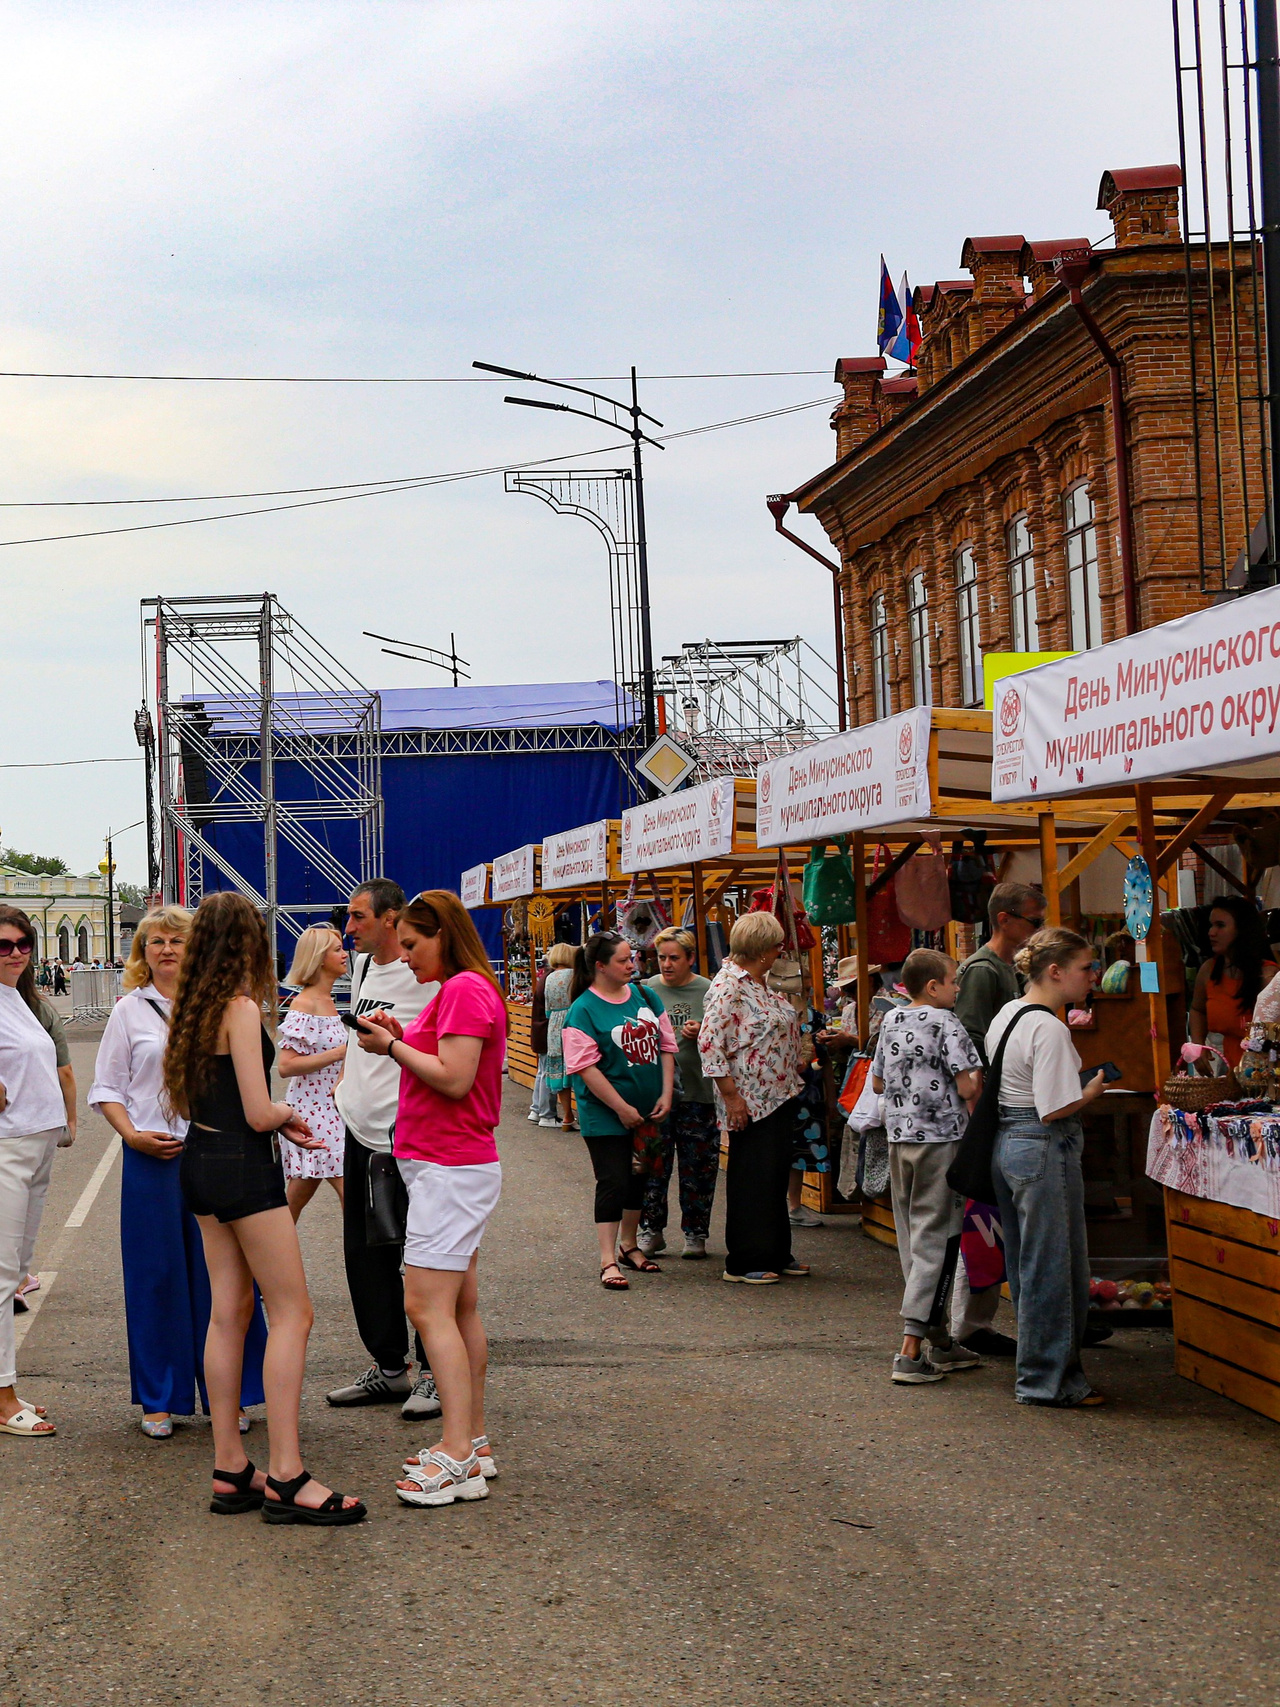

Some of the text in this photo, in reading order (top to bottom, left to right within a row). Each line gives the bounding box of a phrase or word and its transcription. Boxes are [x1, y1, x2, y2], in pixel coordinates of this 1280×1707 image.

[1064, 621, 1280, 722] День Минусинского
[1045, 700, 1213, 778] муниципального
[788, 747, 873, 796] День Минусинского
[780, 782, 882, 832] муниципального округа
